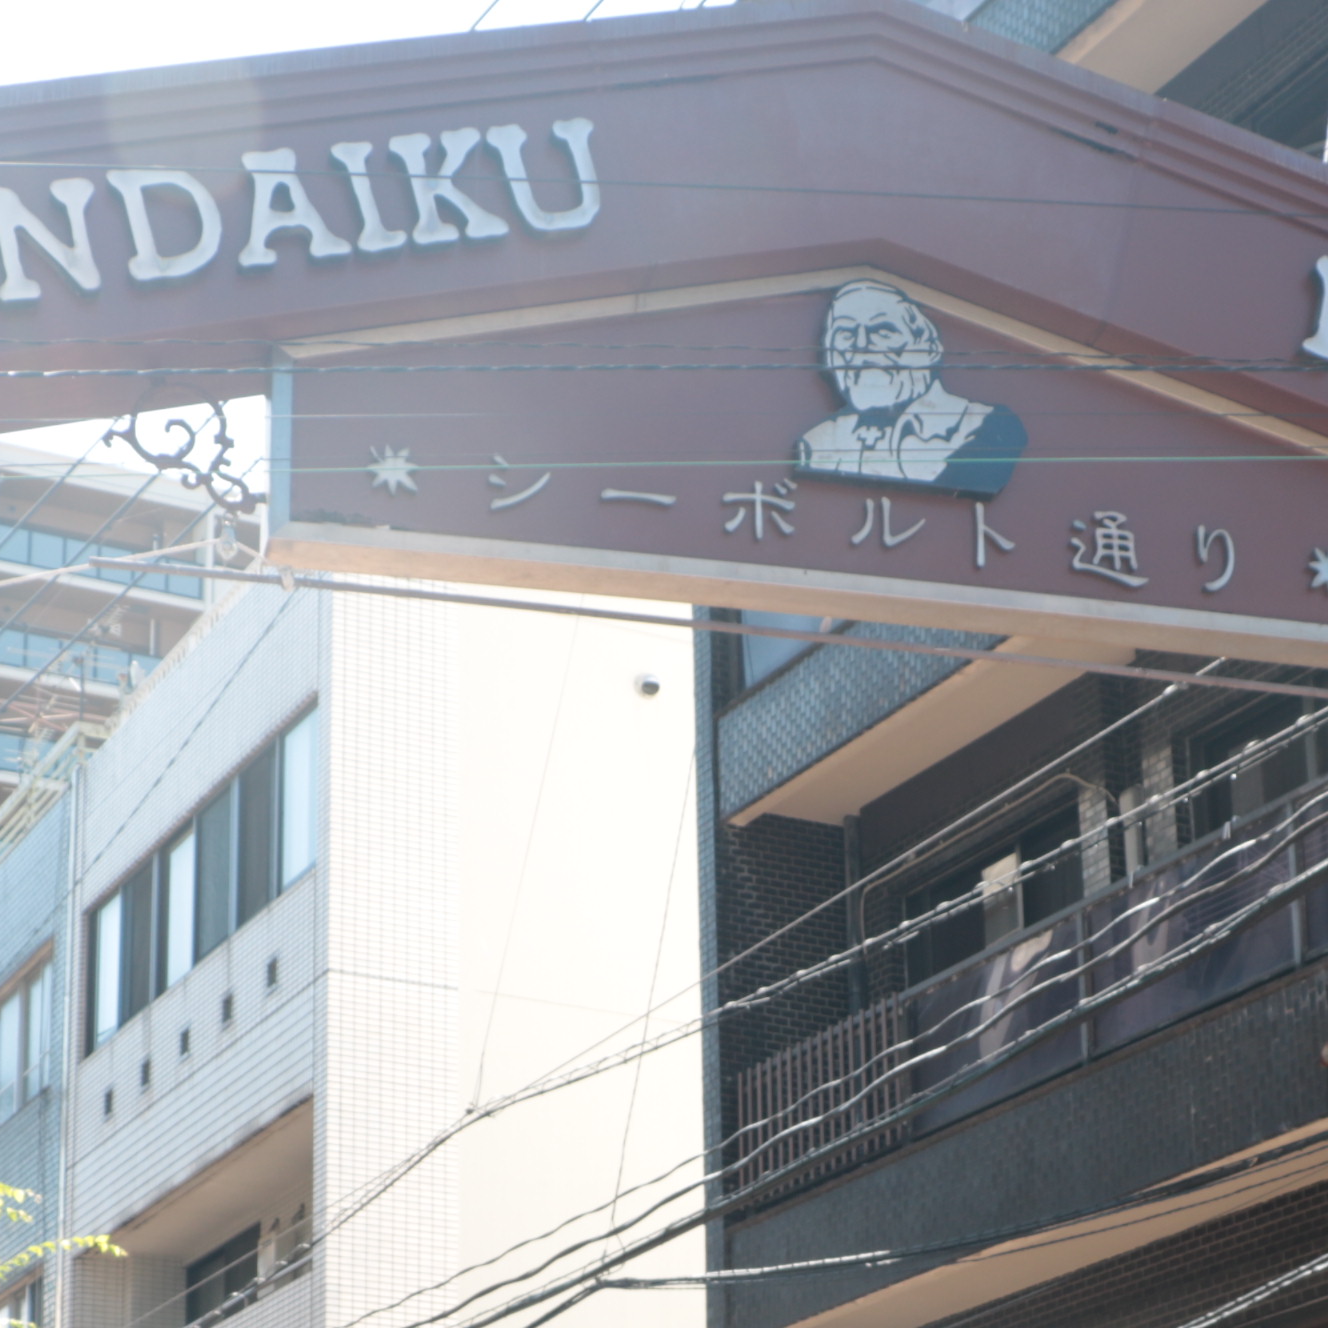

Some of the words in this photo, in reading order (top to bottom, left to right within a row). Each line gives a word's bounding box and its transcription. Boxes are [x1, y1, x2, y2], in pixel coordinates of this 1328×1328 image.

[487, 452, 1236, 592] シーボルト通り
